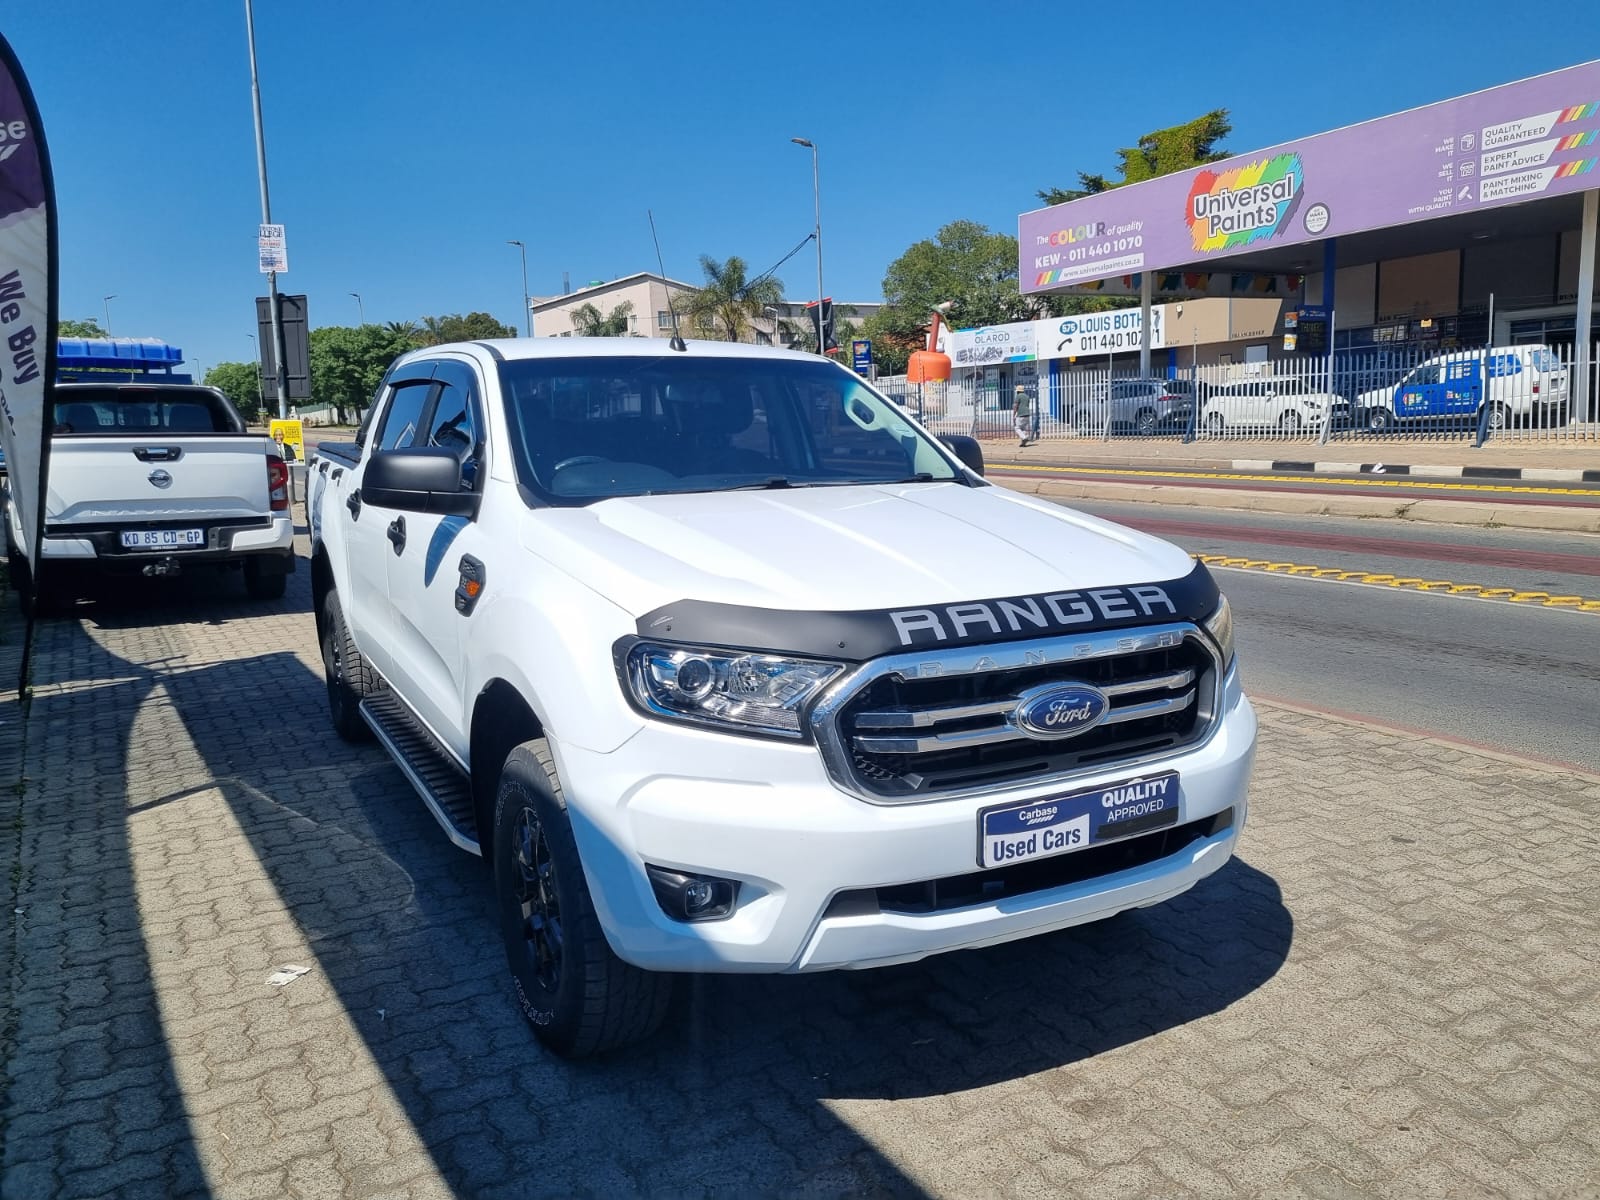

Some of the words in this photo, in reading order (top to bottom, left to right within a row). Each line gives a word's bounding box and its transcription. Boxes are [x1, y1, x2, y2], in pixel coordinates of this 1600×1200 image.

[1484, 126, 1546, 146] GUARANTEED
[1485, 123, 1522, 138] QUALITY
[1435, 143, 1454, 153] MAKE
[1443, 137, 1455, 145] WE
[1483, 161, 1510, 172] PAINT
[1511, 153, 1545, 167] ADVICE
[1484, 150, 1518, 164] EXPERT
[1438, 169, 1453, 178] SELL
[1483, 178, 1510, 190] PAINT
[1510, 172, 1543, 185] MIXING
[1195, 175, 1293, 217] Universal
[1433, 194, 1453, 203] PAINT
[1439, 187, 1453, 196] YOU
[1490, 182, 1537, 197] MATCHING
[1408, 205, 1425, 215] WITH
[1425, 201, 1452, 212] QUALITY
[1210, 204, 1275, 236] Paints
[1036, 235, 1049, 246] The
[1049, 221, 1106, 248] COLOUR
[1106, 225, 1117, 236] of
[1116, 219, 1144, 234] quality
[1035, 253, 1061, 269] KEW
[1069, 247, 1086, 261] 011
[1088, 242, 1111, 256] 440
[1113, 235, 1143, 252] 1070
[1063, 258, 1141, 277] www.universalpaints.co.za
[0, 269, 26, 324] We
[1061, 322, 1076, 332] 575
[1079, 316, 1111, 334] LOUIS
[1114, 312, 1143, 330] BOTH
[1081, 335, 1097, 351] 011
[1100, 333, 1123, 349] 440
[7, 324, 41, 385] Buy
[124, 533, 139, 544] KD
[144, 532, 158, 543] 85
[163, 532, 177, 543] CD
[186, 531, 201, 543] GP
[889, 585, 1177, 646] RANGER
[1045, 697, 1092, 726] Ford
[1101, 779, 1169, 808] QUALITY
[1018, 806, 1058, 821] Carbase
[1107, 799, 1164, 824] APPROVED
[993, 832, 1037, 862] Used
[1042, 828, 1081, 851] Cars
